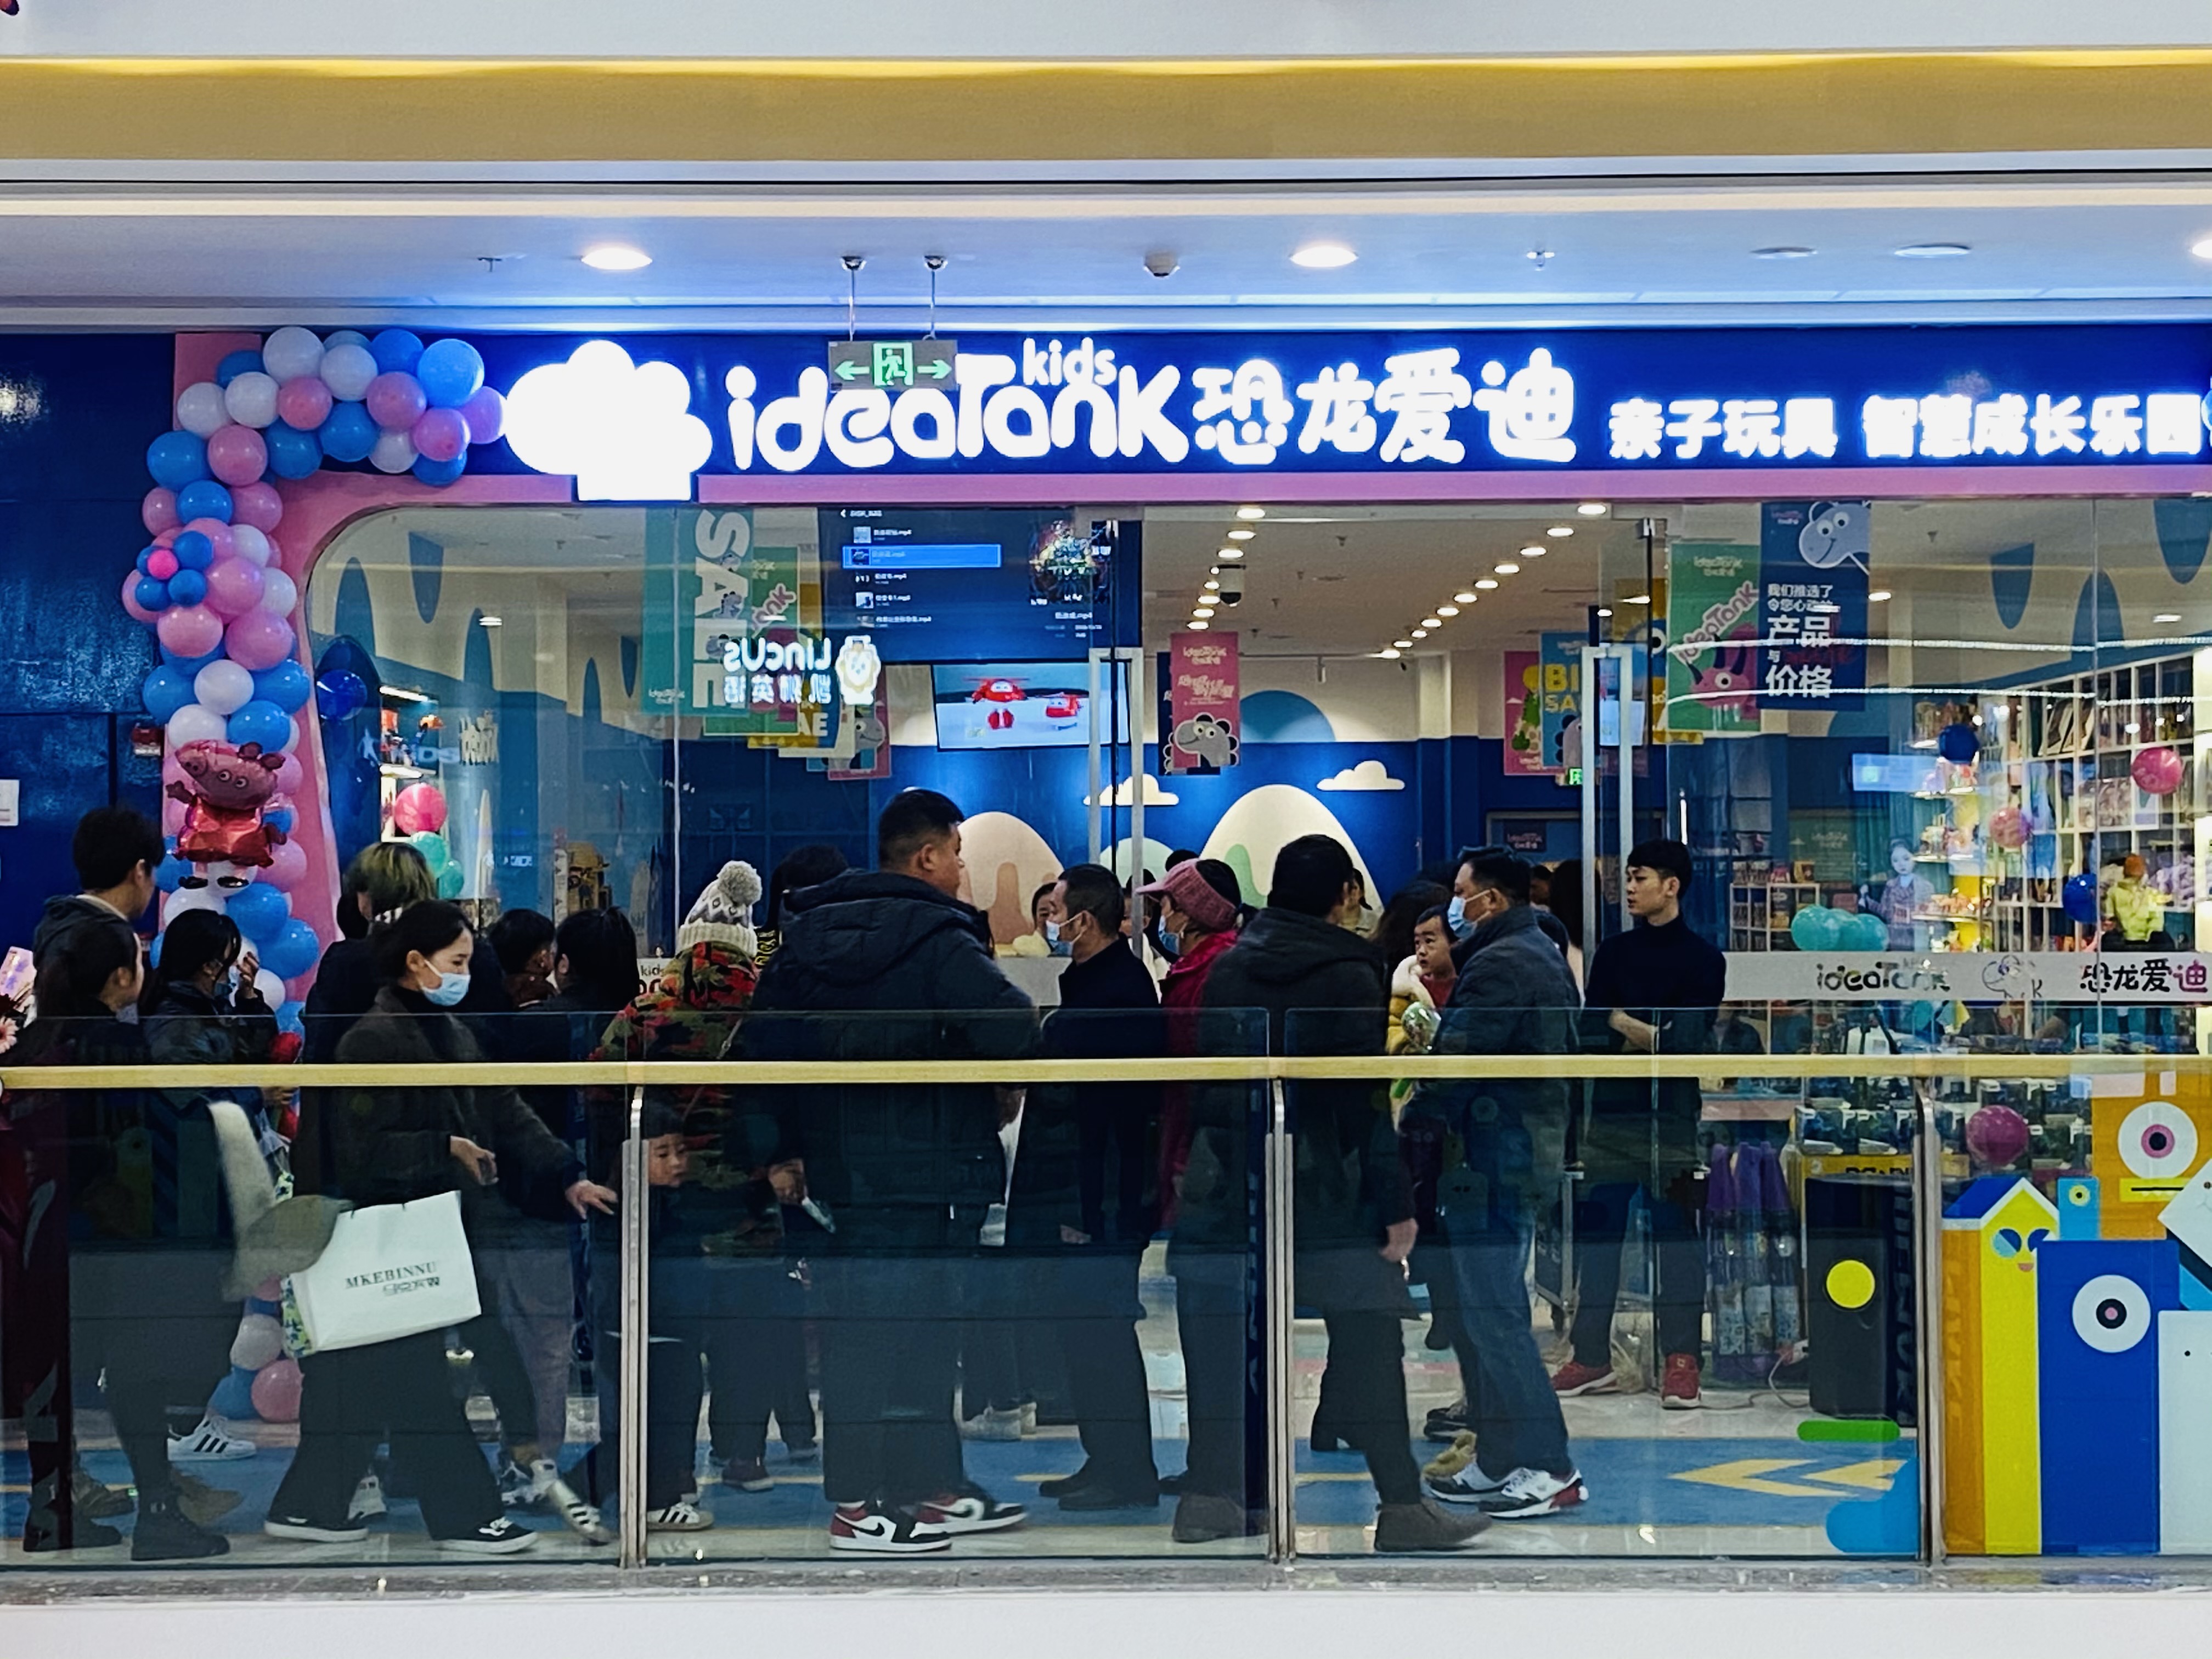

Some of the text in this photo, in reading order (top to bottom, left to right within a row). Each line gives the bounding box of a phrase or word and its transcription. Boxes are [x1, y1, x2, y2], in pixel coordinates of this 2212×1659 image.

[1023, 337, 1116, 386] kids
[1192, 347, 1576, 465] 恐龙爱迪
[1609, 393, 2201, 459] 亲子玩具 智慧成长乐园
[1767, 614, 1830, 647] 产品
[1767, 650, 1780, 663] 与
[1545, 664, 1579, 692] BI
[1765, 664, 1832, 698] 价格
[1545, 695, 1577, 713] SA
[641, 964, 661, 976] kid
[2080, 958, 2208, 994] 恐龙爱迪
[346, 1261, 438, 1289] MKEBINNU
